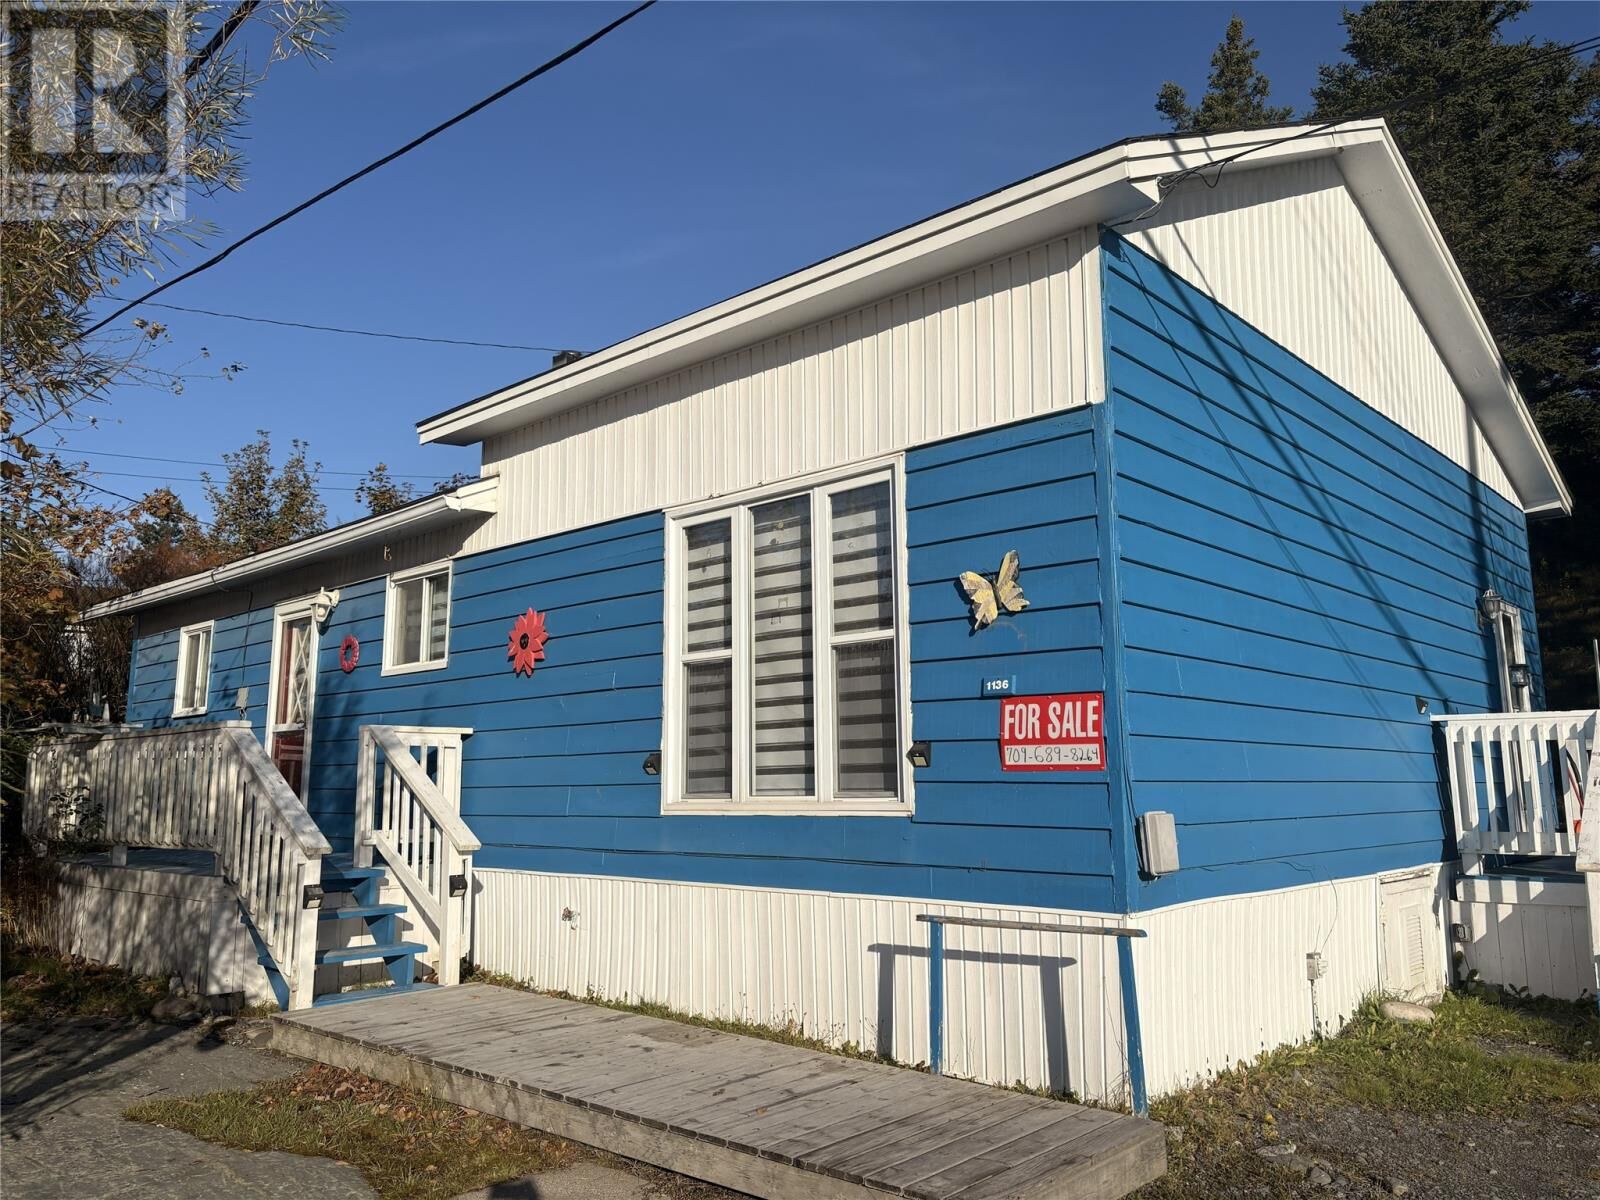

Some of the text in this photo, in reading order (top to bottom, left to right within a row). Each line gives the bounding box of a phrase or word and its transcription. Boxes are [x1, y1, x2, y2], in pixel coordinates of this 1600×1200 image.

[986, 680, 1009, 691] 1136
[1004, 700, 1099, 739] FOR SALE
[1006, 746, 1099, 763] 709-689-8264
